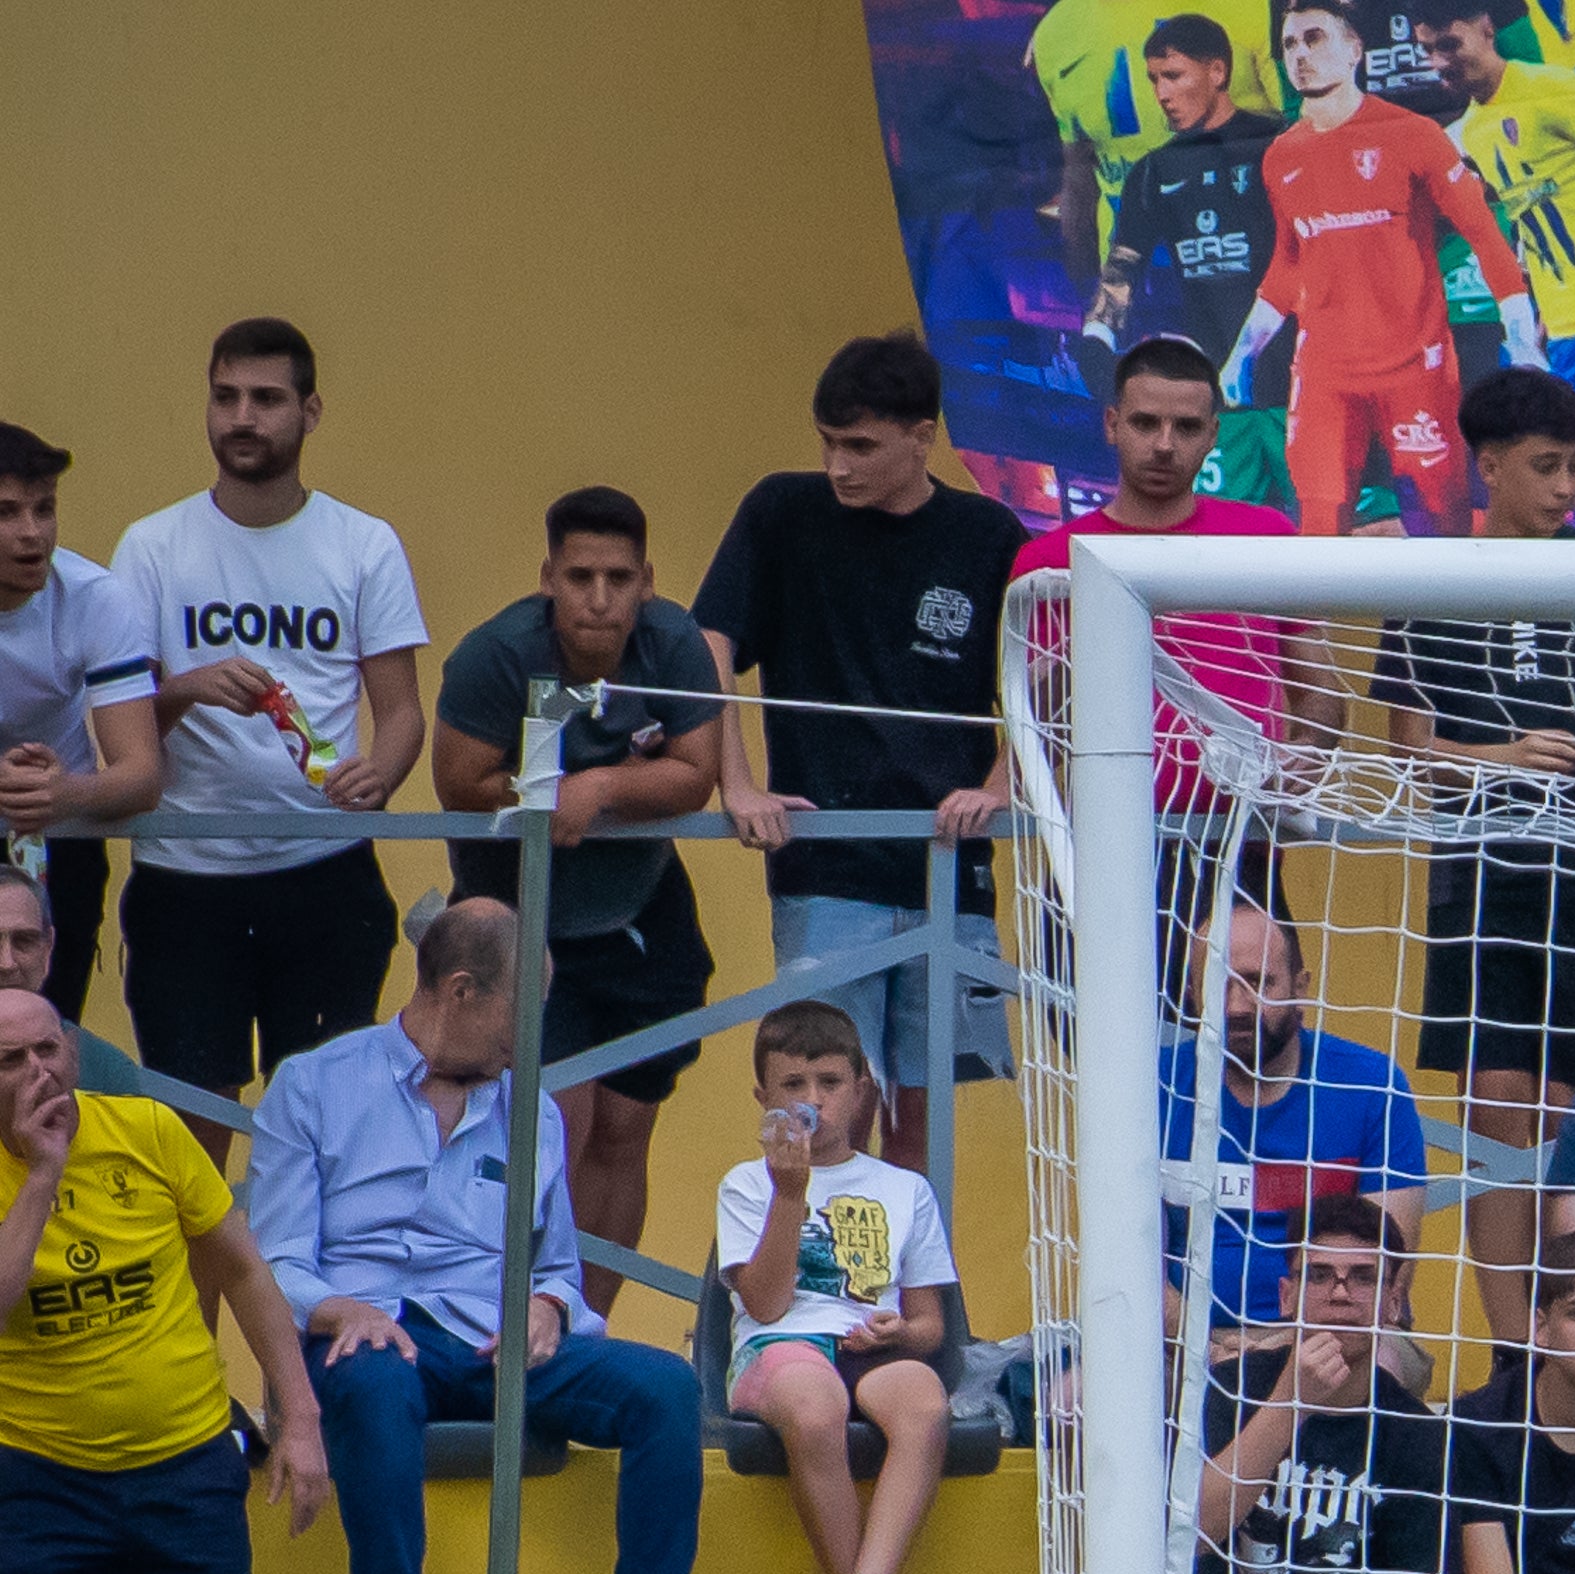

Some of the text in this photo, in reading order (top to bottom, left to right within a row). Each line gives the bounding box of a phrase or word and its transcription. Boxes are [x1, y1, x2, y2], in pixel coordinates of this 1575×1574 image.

[1175, 232, 1250, 265] EAS
[184, 603, 341, 651] ICONO
[837, 1227, 883, 1249] FEST
[28, 1260, 156, 1317] EAS
